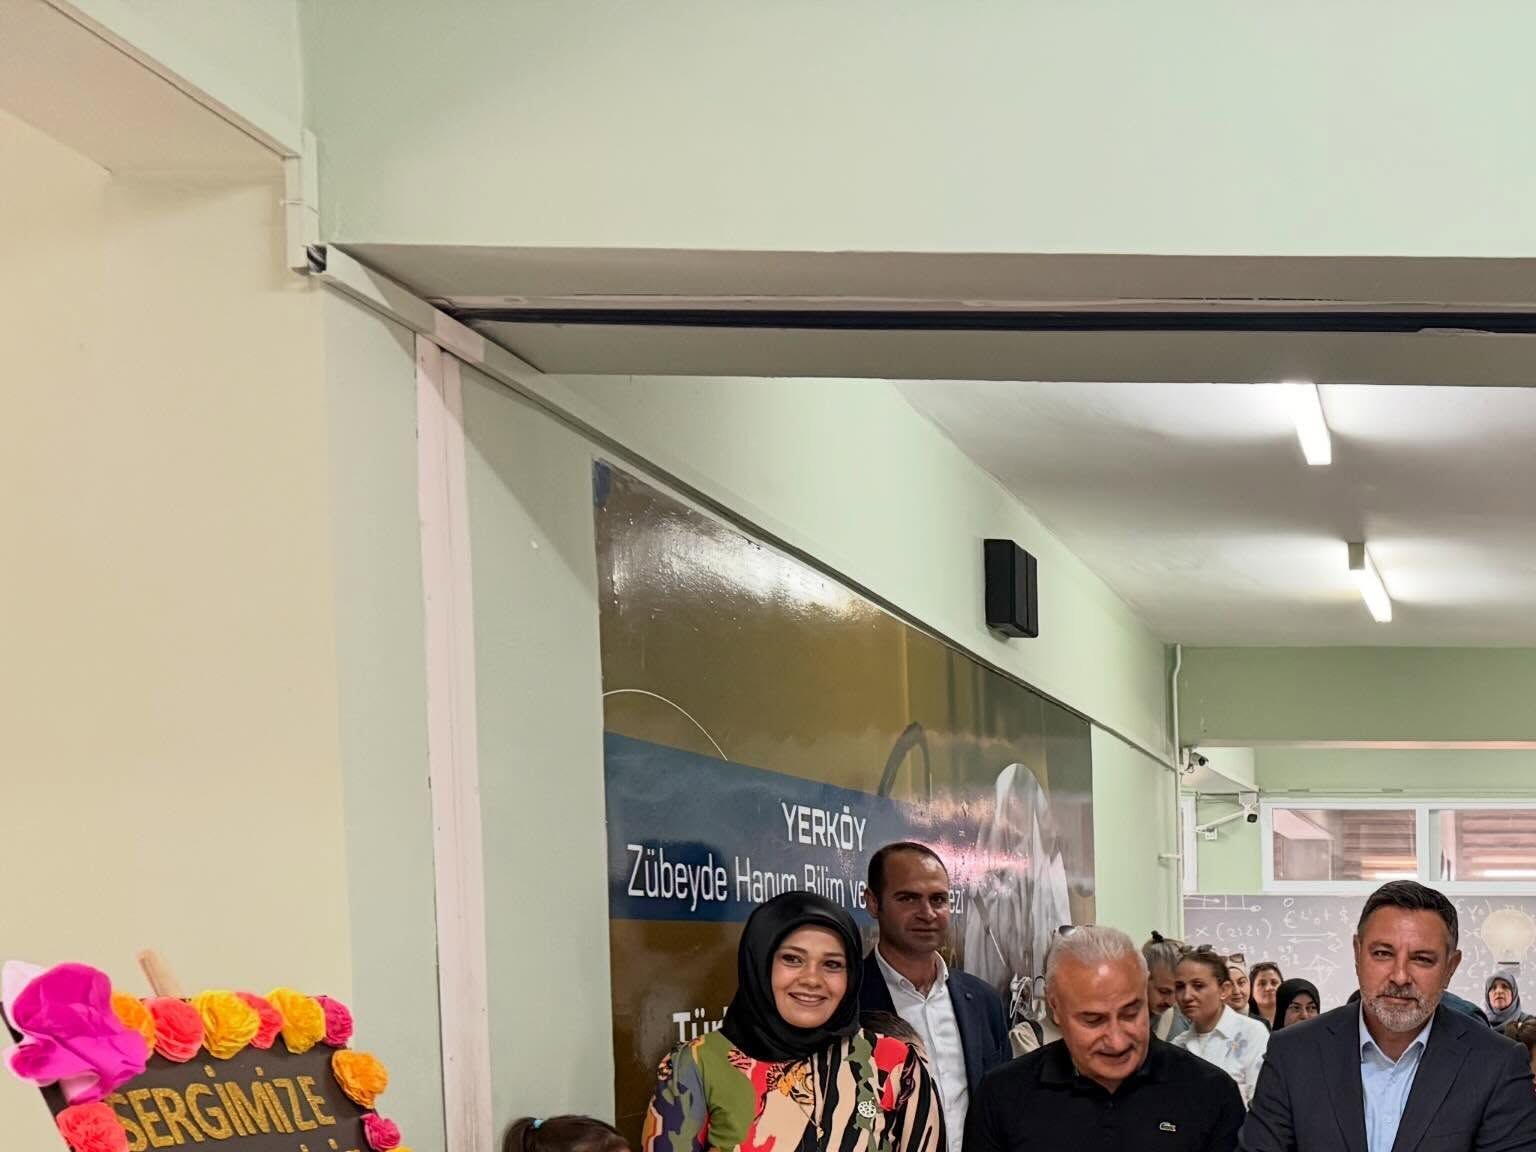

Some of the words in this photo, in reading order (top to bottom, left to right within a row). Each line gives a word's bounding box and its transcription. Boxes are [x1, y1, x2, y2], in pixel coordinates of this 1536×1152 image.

[781, 802, 867, 852] YERKÖY
[626, 843, 728, 912] Zübeyde
[734, 855, 798, 904] Hanım
[804, 863, 845, 908] Bilim
[849, 879, 867, 909] ve
[104, 1063, 337, 1152] SERGİMİZE
